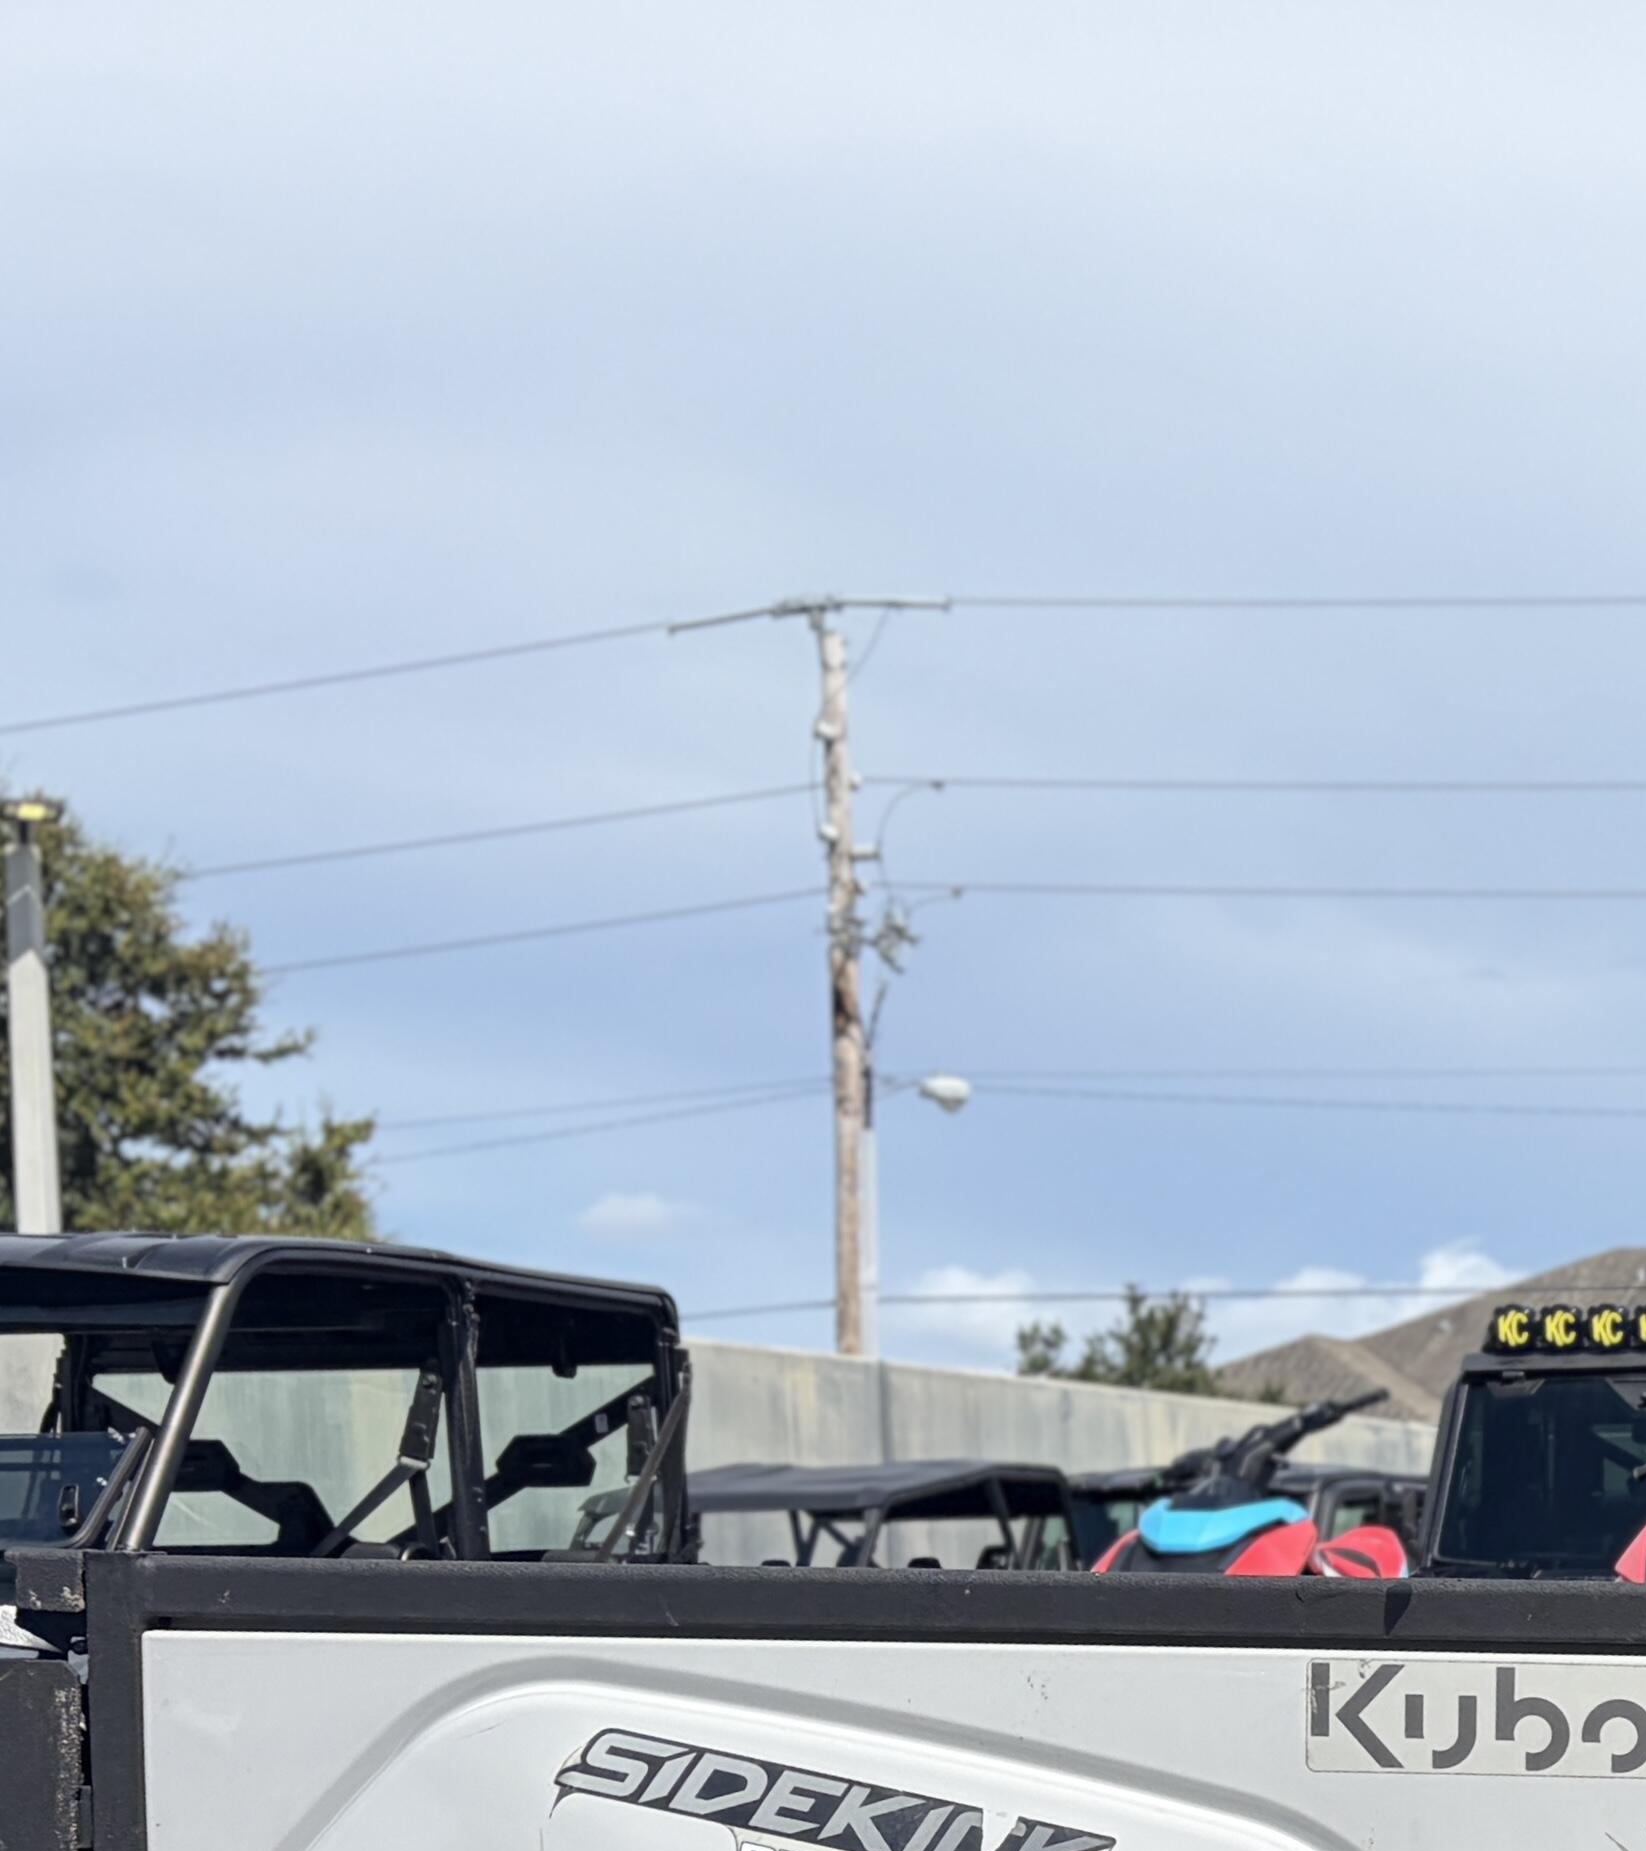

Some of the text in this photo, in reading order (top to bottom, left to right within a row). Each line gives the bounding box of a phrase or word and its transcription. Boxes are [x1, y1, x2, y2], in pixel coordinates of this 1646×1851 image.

[1498, 1310, 1529, 1345] KC
[1545, 1310, 1576, 1346] KC
[1592, 1310, 1623, 1345] KC
